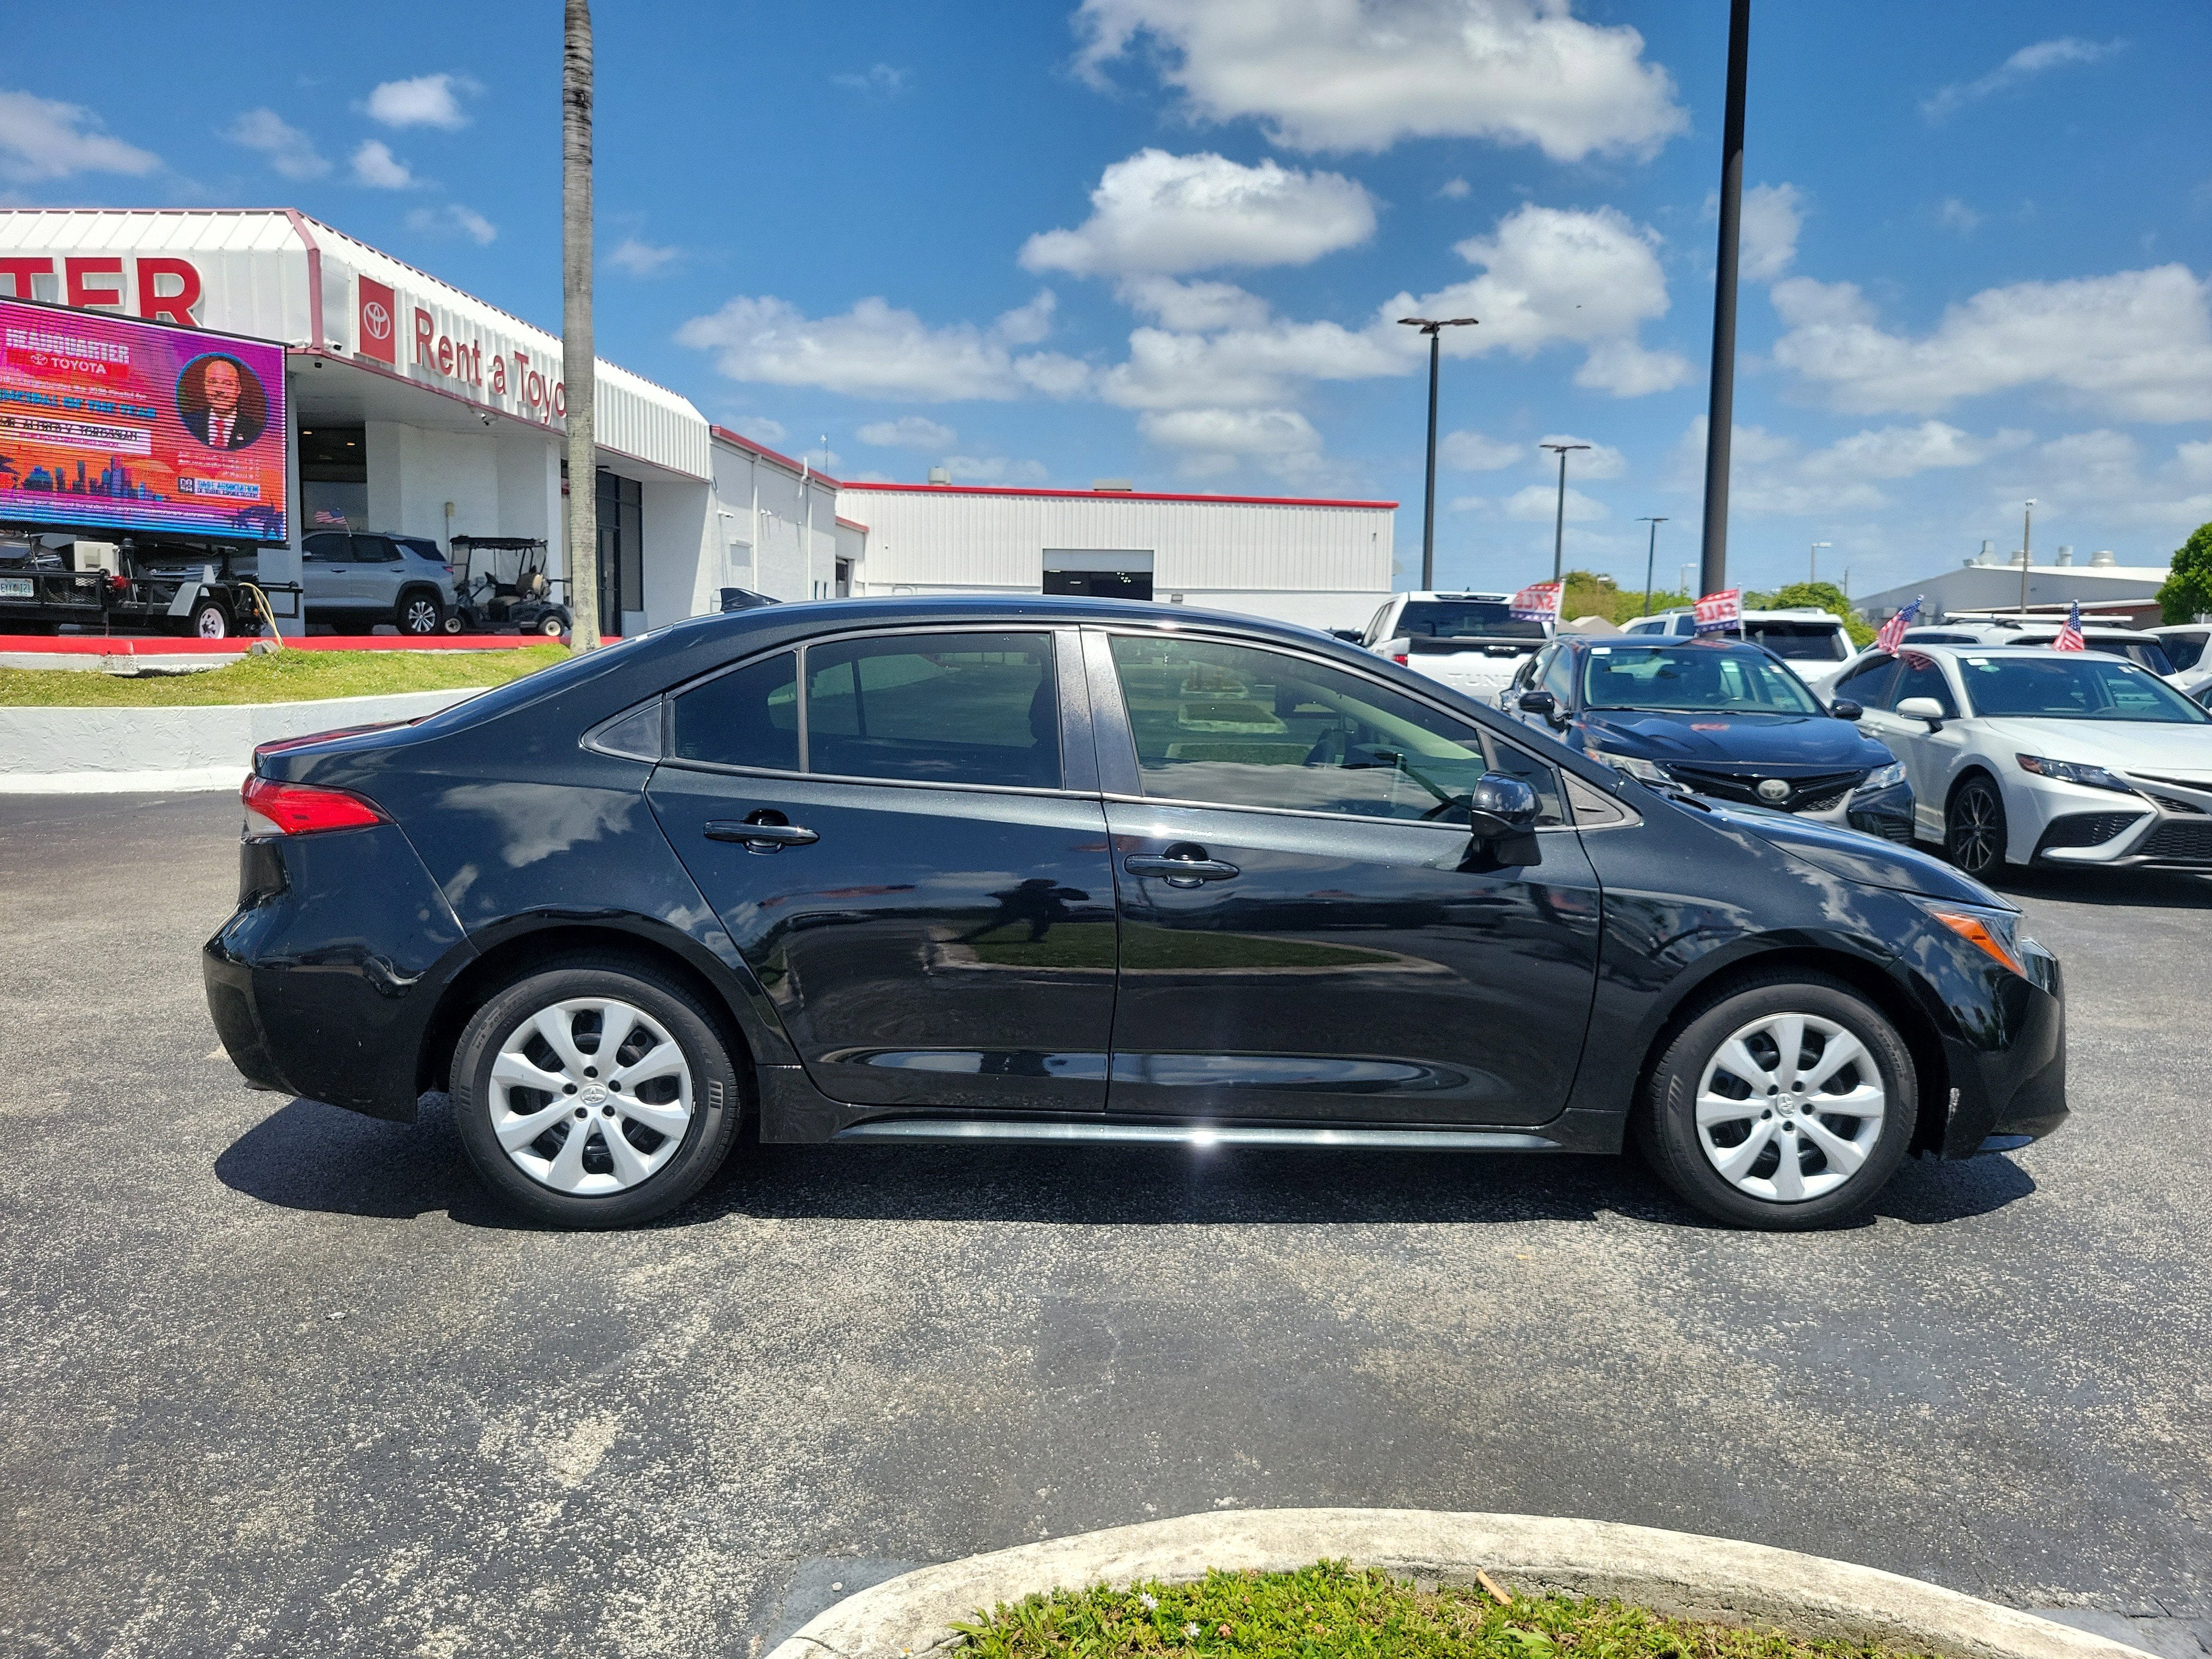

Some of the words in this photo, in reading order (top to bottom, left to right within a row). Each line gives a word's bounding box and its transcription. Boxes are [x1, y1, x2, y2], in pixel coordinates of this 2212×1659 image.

[6, 329, 129, 364] HEADQUARTER
[415, 306, 482, 387] Rent
[493, 354, 507, 395] a
[52, 357, 107, 375] TOYOTA
[62, 397, 83, 410] OF
[87, 399, 116, 414] THE
[119, 404, 156, 418] YEAR
